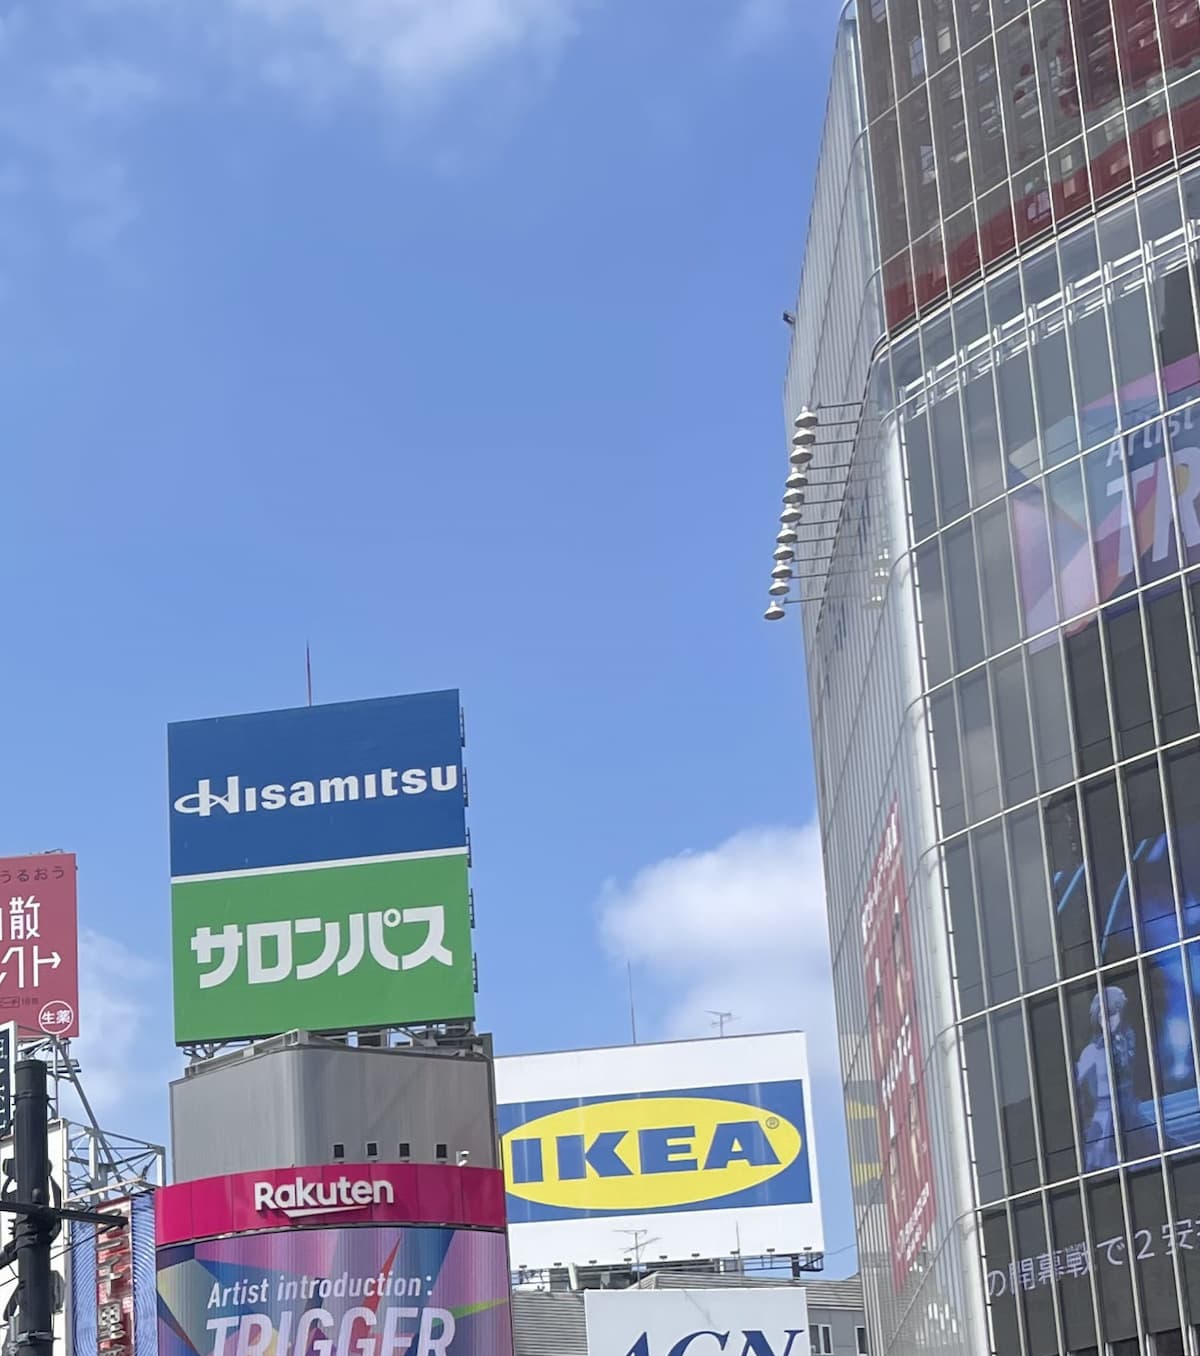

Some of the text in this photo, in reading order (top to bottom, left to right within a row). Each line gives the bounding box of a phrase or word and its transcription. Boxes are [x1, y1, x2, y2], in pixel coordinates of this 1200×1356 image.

[174, 765, 457, 816] Hisamitsu
[191, 905, 453, 989] サロンパス
[41, 1009, 72, 1026] 生薬
[511, 1120, 782, 1184] IKEA
[254, 1177, 394, 1212] Rakuten
[207, 1271, 433, 1309] Artist introduction:
